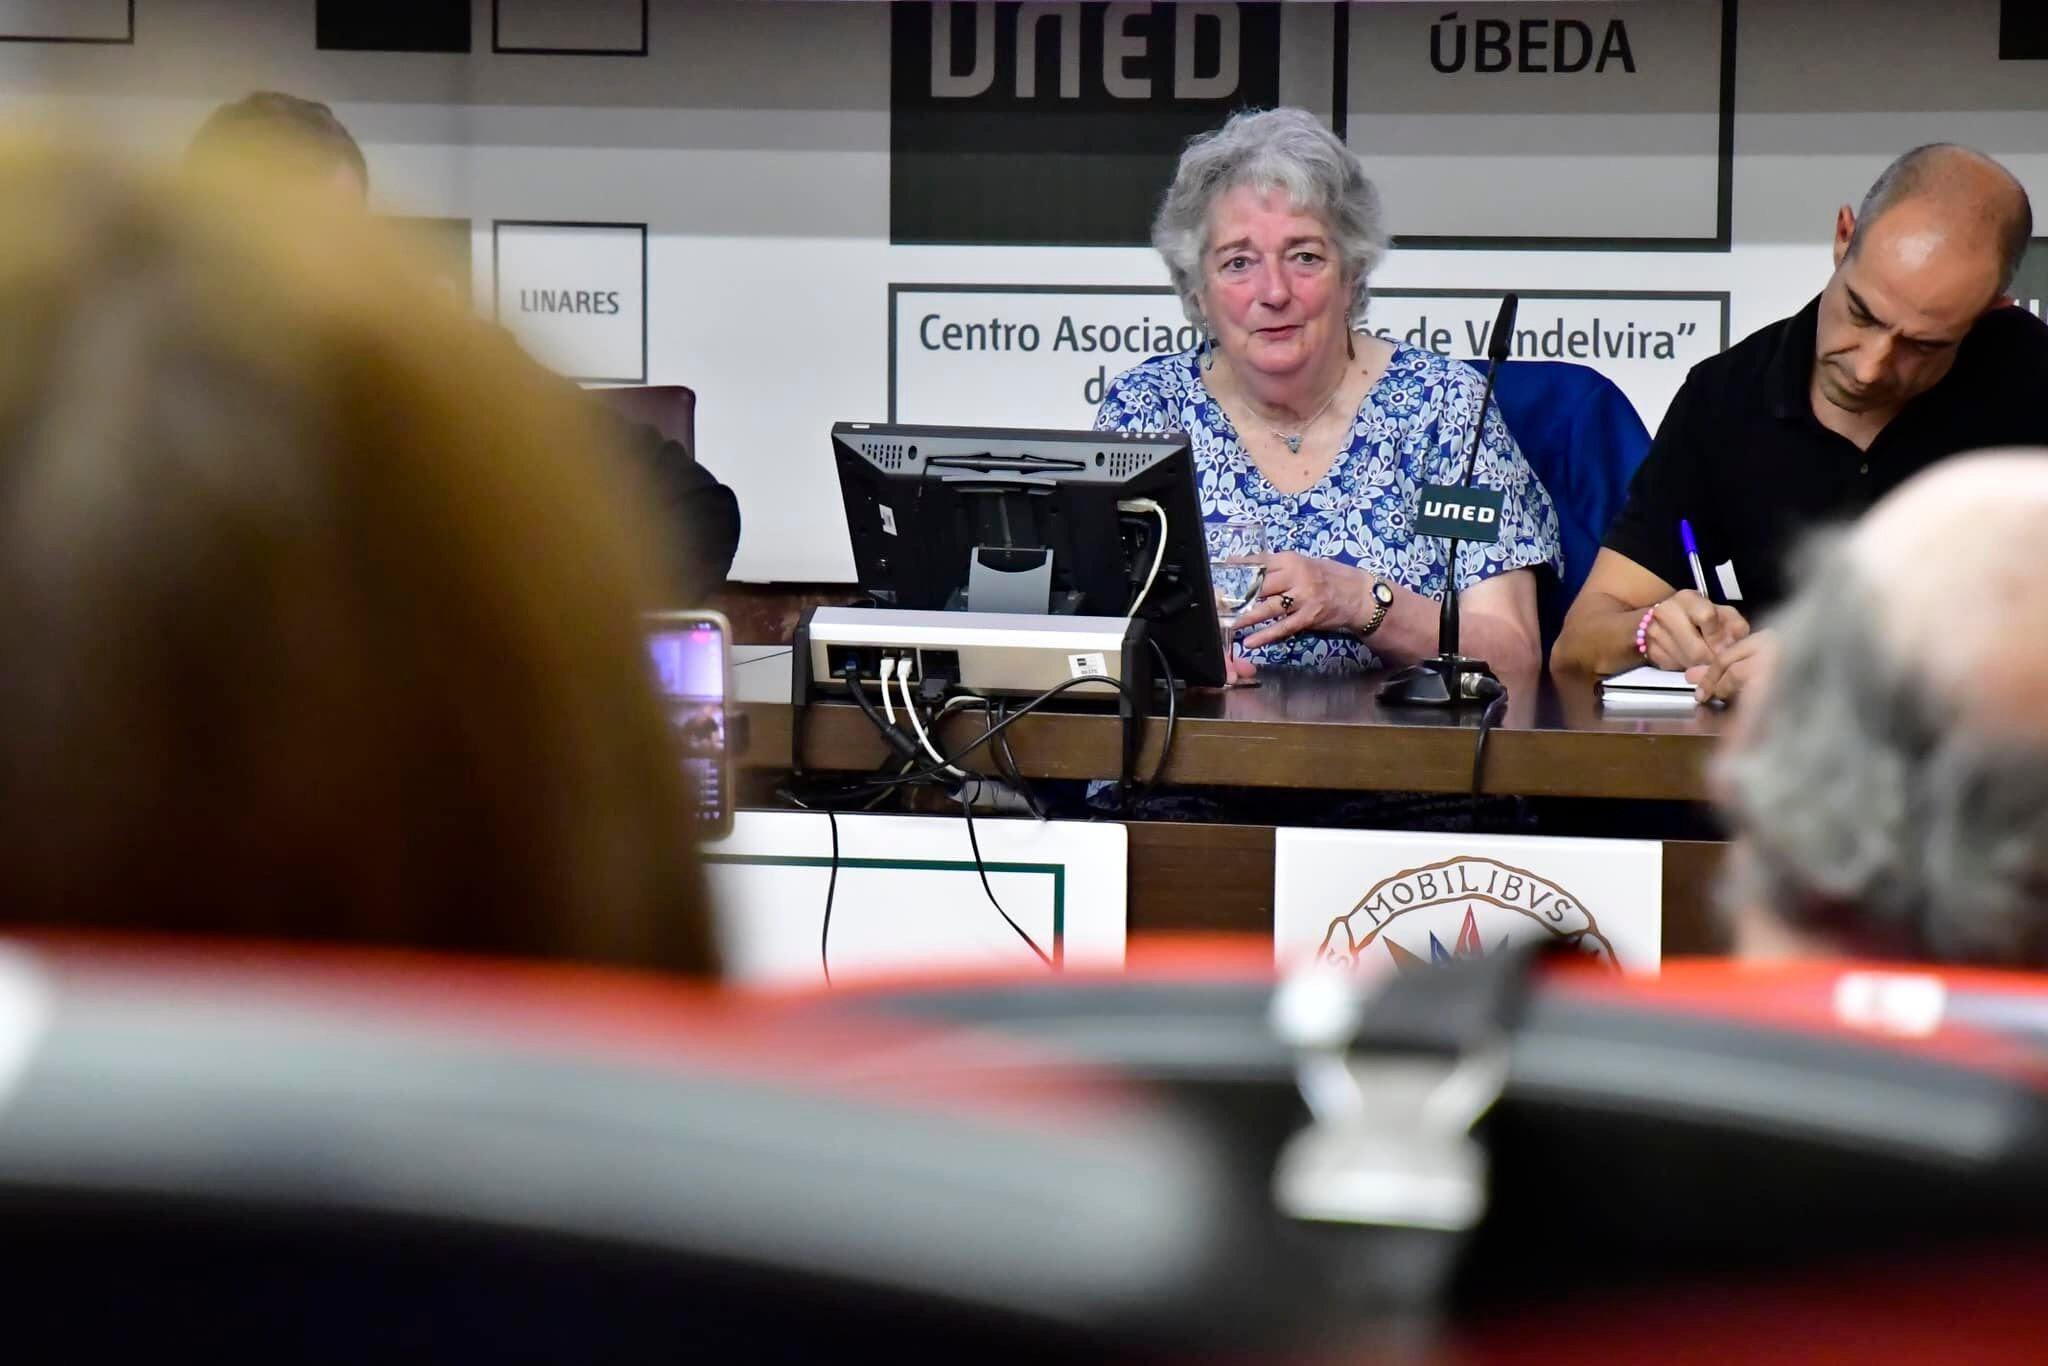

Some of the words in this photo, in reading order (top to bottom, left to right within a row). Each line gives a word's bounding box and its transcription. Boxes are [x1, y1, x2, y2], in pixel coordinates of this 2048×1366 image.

[931, 0, 1241, 99] UNED
[1430, 11, 1636, 73] ÚBEDA
[520, 289, 620, 315] LINARES
[919, 313, 1040, 351] Centro
[1053, 315, 1198, 353] Asociad
[1405, 315, 1452, 356] de
[1464, 317, 1697, 360] Vndelvira”
[1424, 500, 1495, 523] UNED
[1363, 865, 1573, 926] MOBILIBVS
